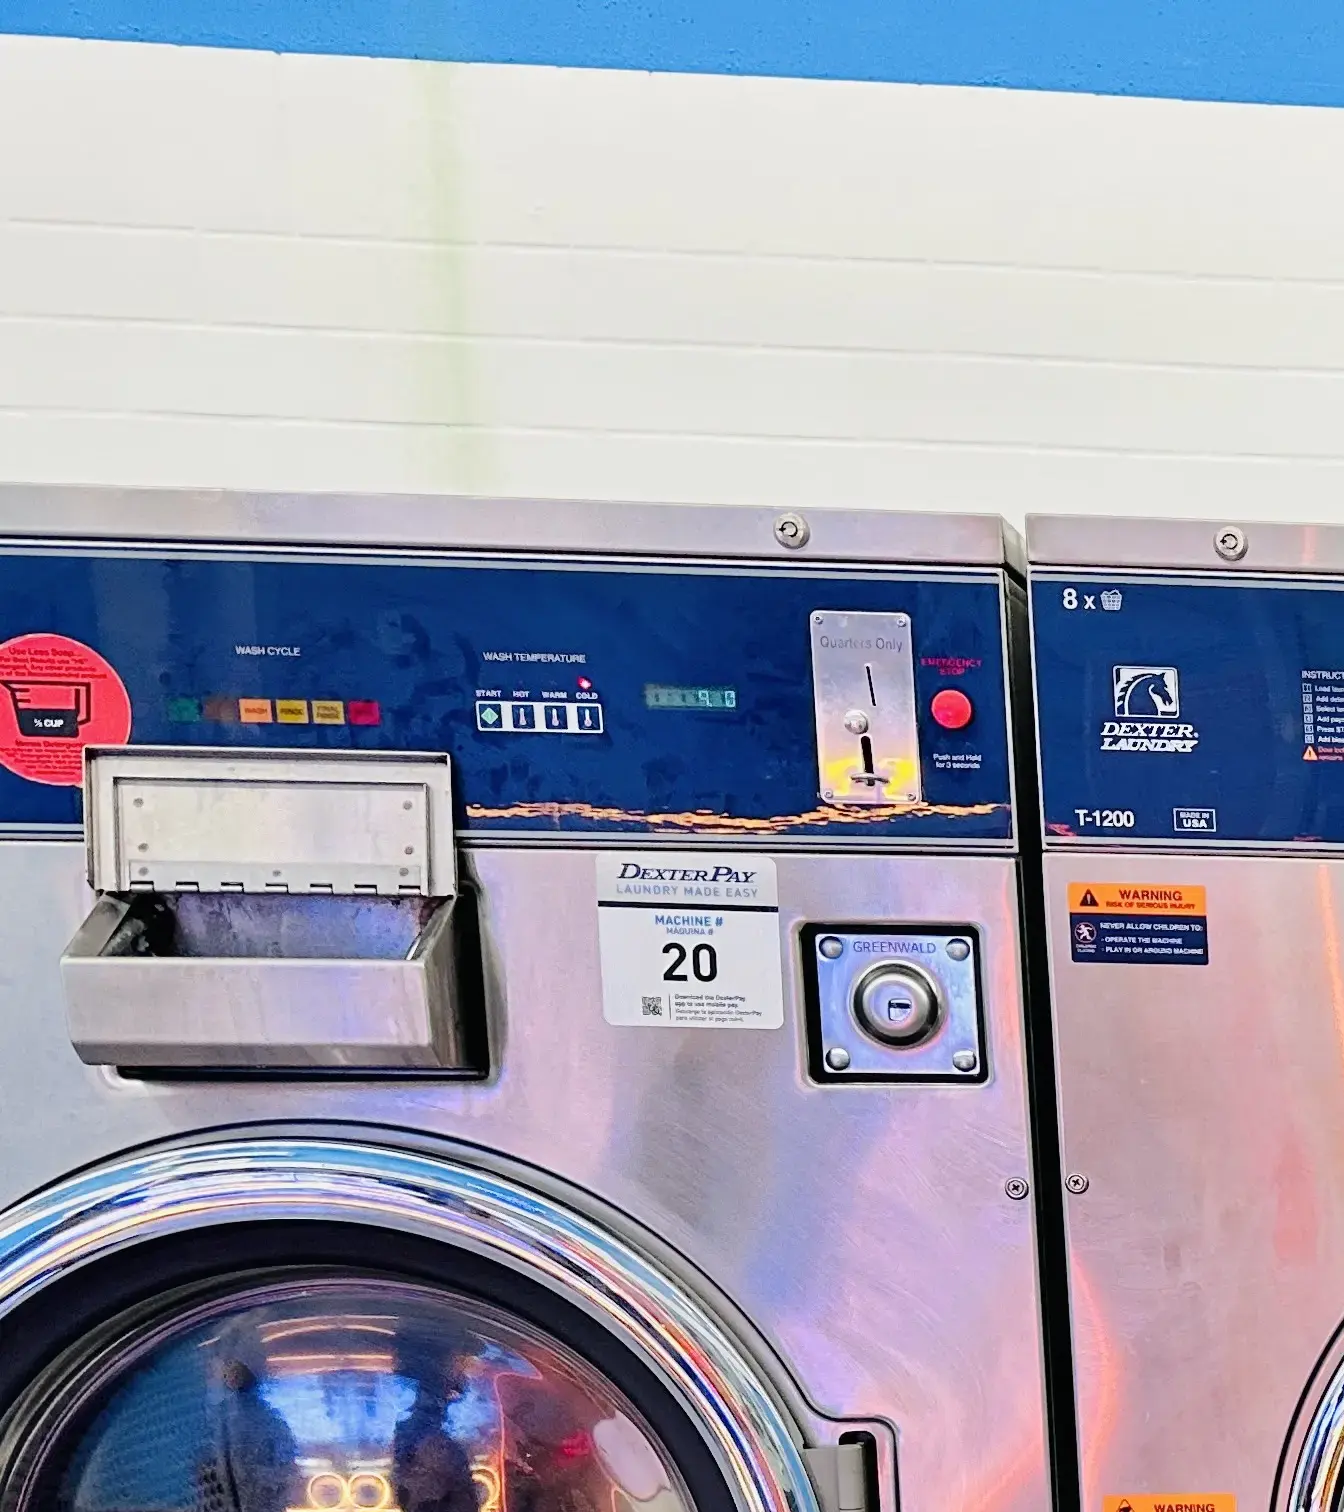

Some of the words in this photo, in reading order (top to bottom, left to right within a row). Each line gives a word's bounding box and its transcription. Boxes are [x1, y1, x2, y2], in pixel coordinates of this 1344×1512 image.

[1063, 588, 1078, 609] 8
[1084, 595, 1095, 609] x
[820, 636, 871, 649] Quarters
[875, 638, 902, 652] Only
[236, 646, 265, 655] WASH
[267, 647, 300, 656] CYCLE
[483, 652, 512, 662] WASH
[514, 653, 586, 663] TEMPERATURE
[513, 690, 529, 698] HOT
[576, 692, 598, 700] COLD
[44, 719, 63, 727] CUP
[1100, 722, 1195, 738] DEXTER
[1100, 739, 1198, 752] LAUNDRY
[1075, 809, 1134, 827] T-1200
[1183, 818, 1207, 828] USA
[617, 884, 678, 895] LAUNDRY
[684, 886, 720, 897] MADE
[726, 888, 758, 898] EASY
[1119, 890, 1182, 901] WARNING
[655, 915, 711, 926] MACHINE
[715, 917, 723, 926] #
[853, 941, 936, 953] GREENWALD
[662, 942, 717, 982] 20
[1154, 1504, 1215, 1512] WARNING
